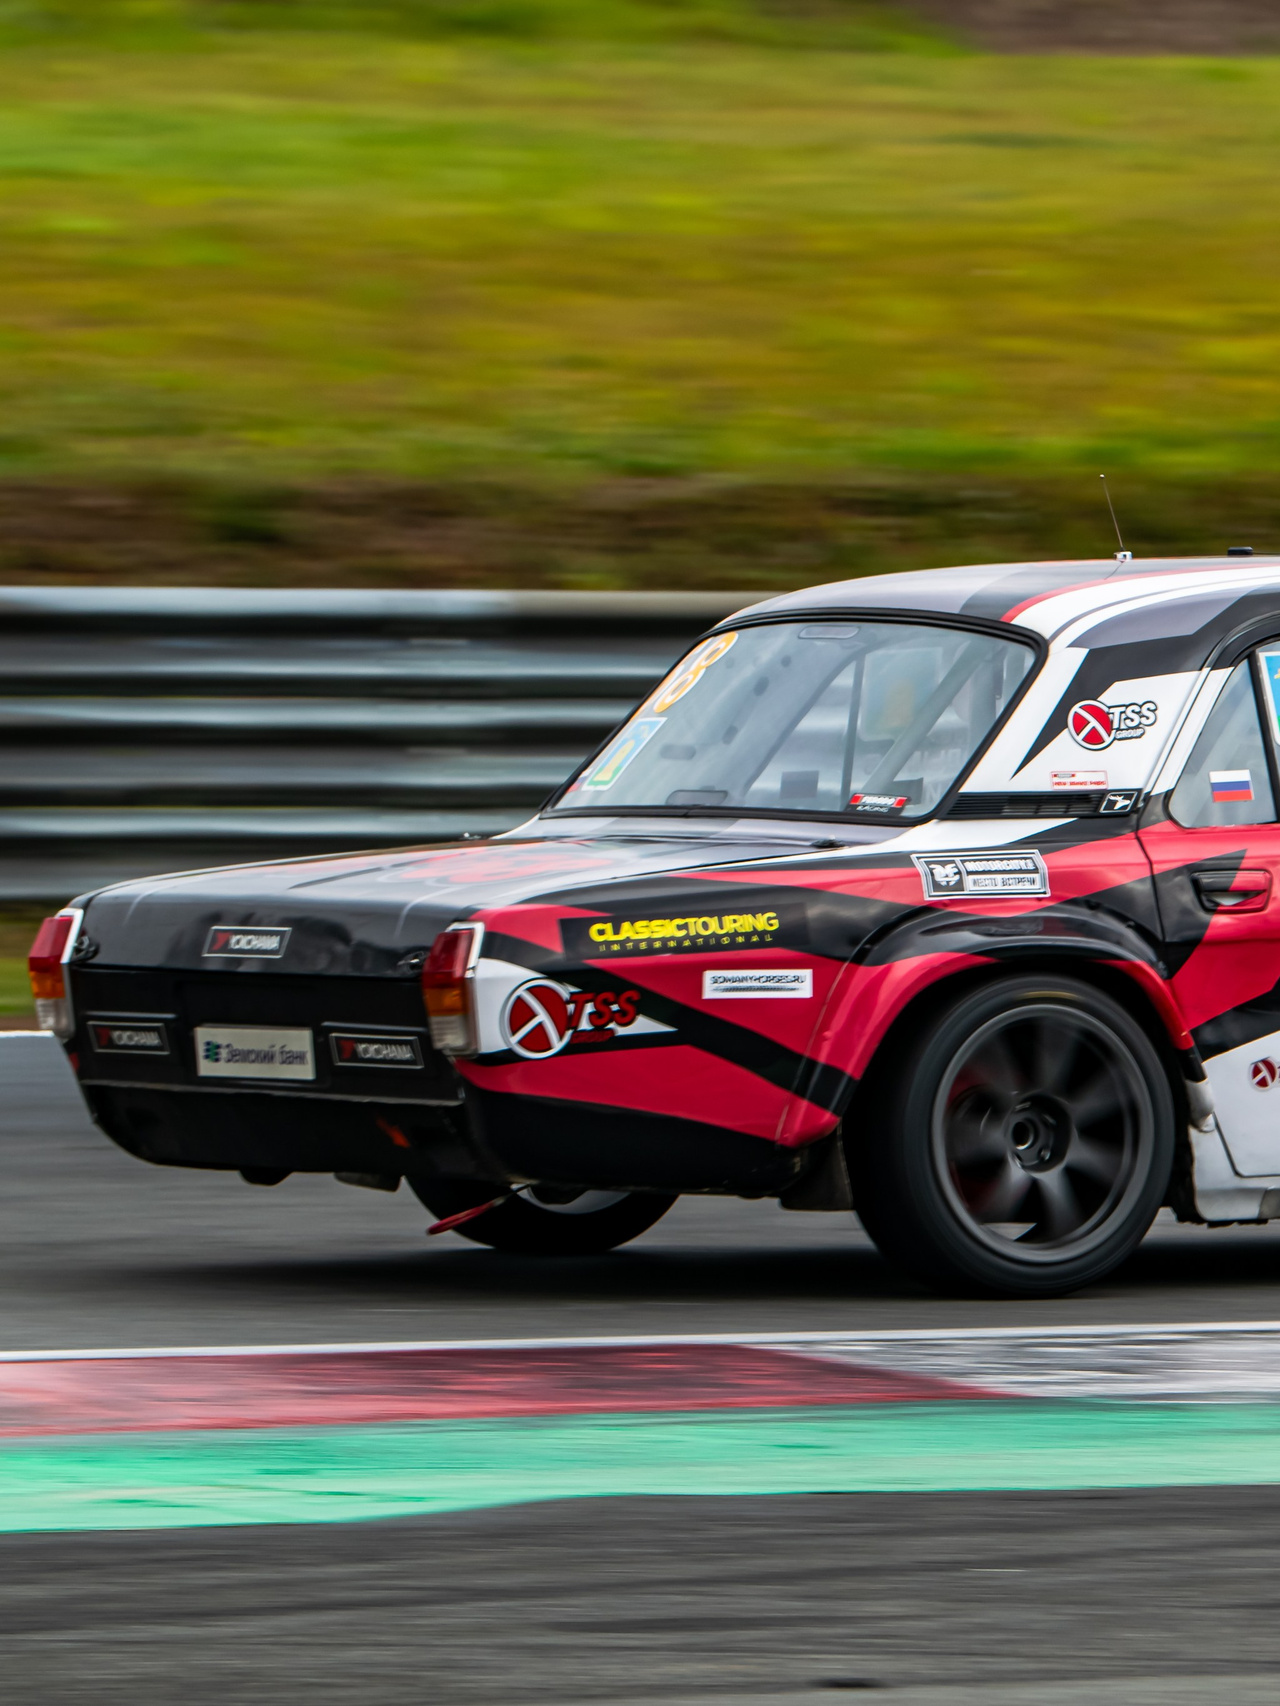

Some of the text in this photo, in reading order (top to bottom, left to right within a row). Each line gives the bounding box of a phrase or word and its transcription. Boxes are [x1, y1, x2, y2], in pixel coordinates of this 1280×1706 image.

[1109, 700, 1158, 729] TSS
[588, 911, 780, 943] CLASSICTOURING
[598, 934, 774, 952] INTERNATIONAL
[569, 990, 641, 1027] TSS
